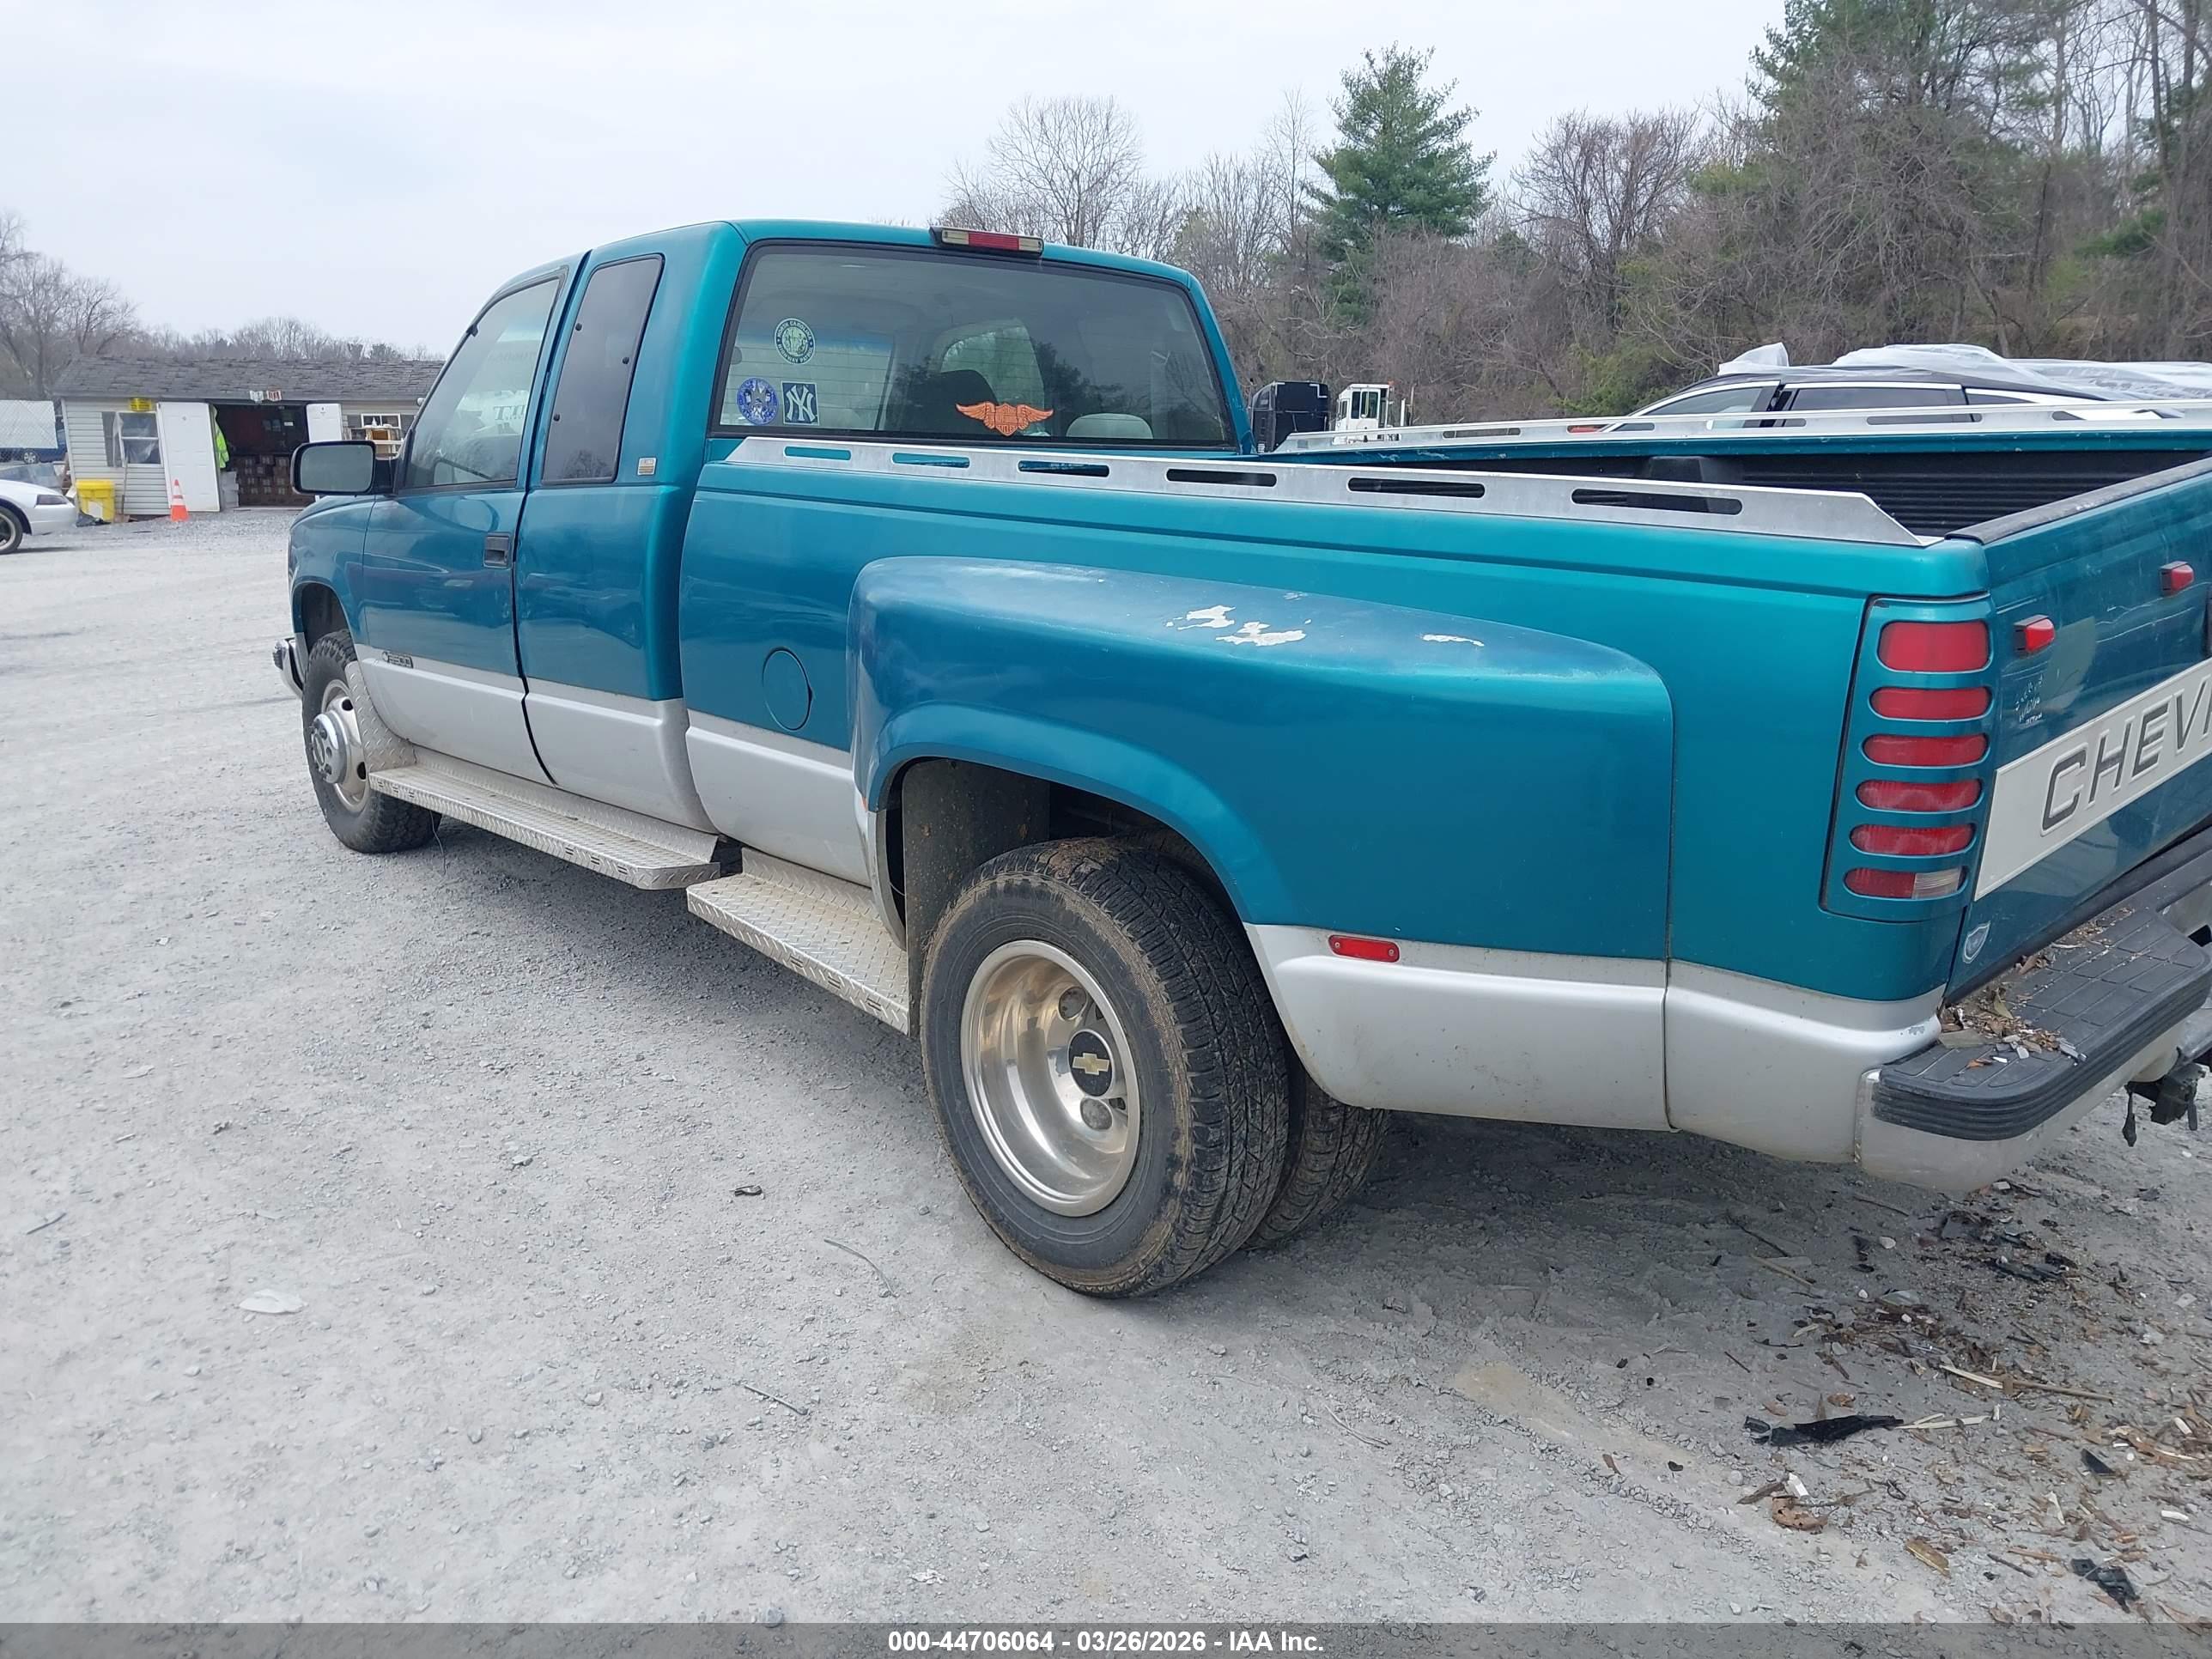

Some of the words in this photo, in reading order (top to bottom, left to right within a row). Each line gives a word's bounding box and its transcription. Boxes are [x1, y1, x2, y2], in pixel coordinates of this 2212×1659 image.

[777, 322, 789, 337] NORTH
[789, 320, 812, 341] CAROLINA
[778, 343, 799, 363] HIGHWAY
[2041, 675, 2212, 836] CHEV
